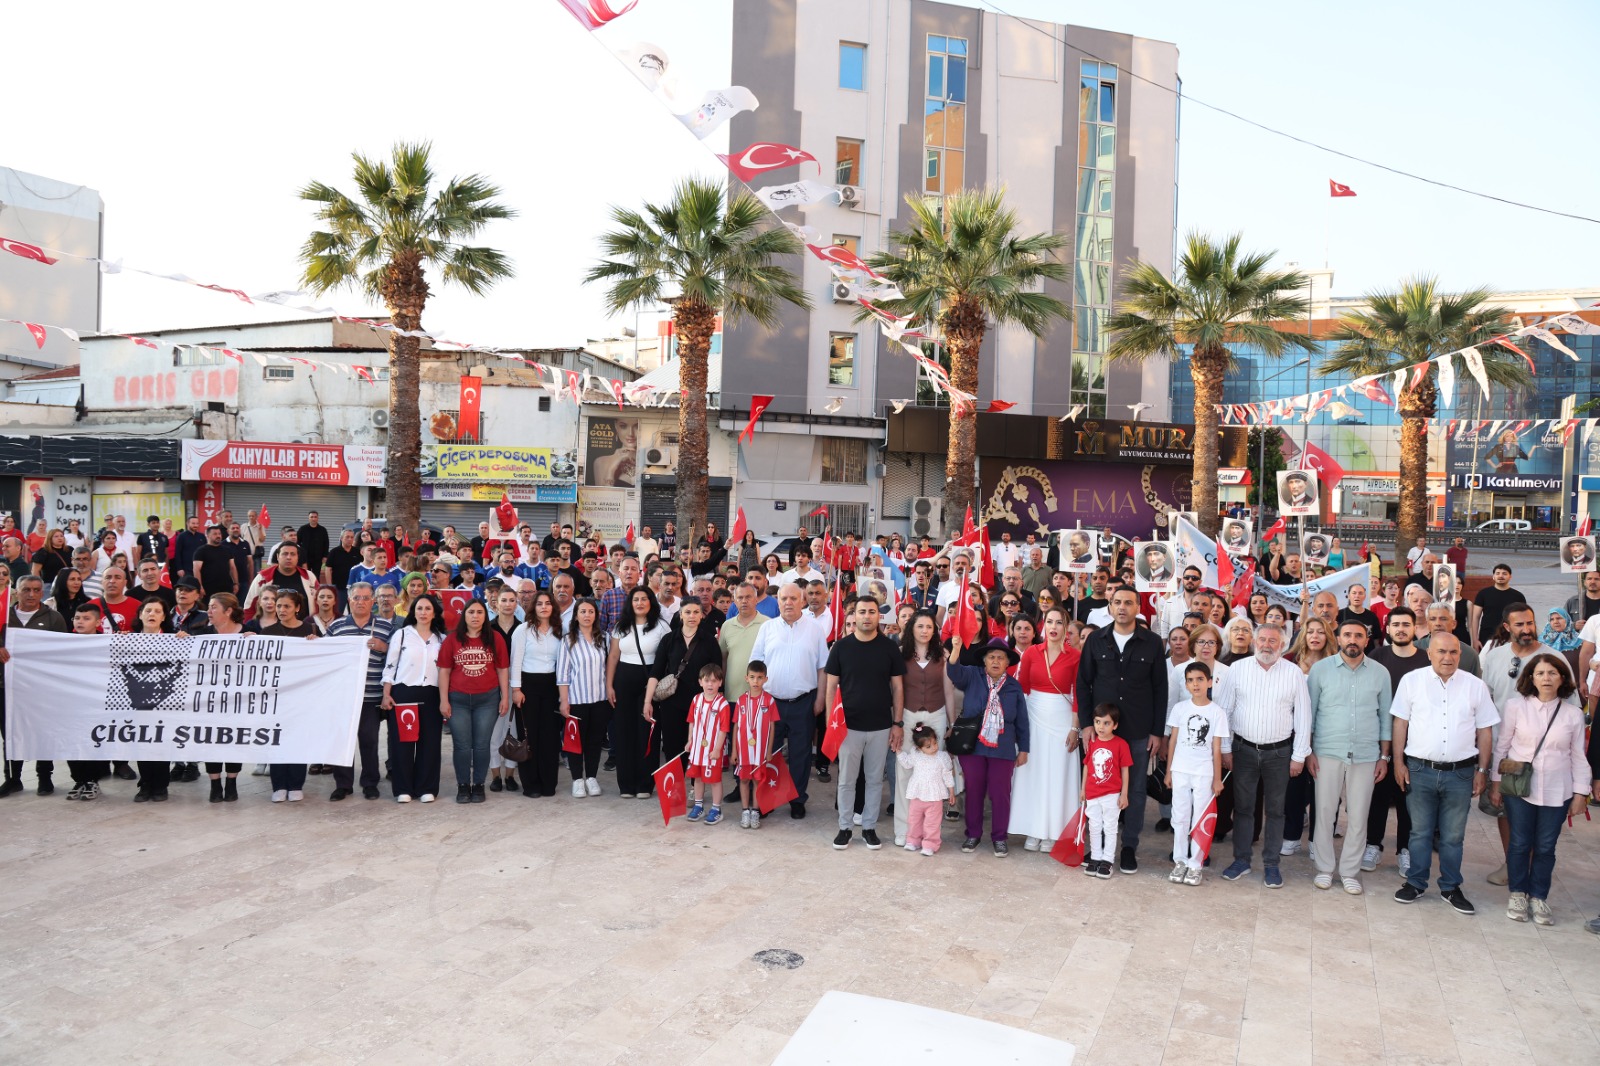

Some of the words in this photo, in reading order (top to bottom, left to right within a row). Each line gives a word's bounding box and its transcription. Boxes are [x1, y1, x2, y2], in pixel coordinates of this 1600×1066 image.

[590, 430, 615, 438] GOLD
[1118, 425, 1224, 450] MUR
[228, 447, 295, 467] KAHYALAR
[298, 450, 339, 469] PERDE
[440, 447, 477, 471] ÇİÇEK
[478, 449, 547, 470] DEPOSUNA
[1119, 450, 1163, 459] KUYUMCULUK
[243, 468, 267, 480] HAKAN
[271, 470, 299, 480] 0536
[301, 471, 315, 480] 511
[317, 472, 328, 480] 41
[330, 472, 341, 481] 01
[1367, 480, 1398, 489] AVRUPADE
[59, 484, 87, 496] Dink
[56, 498, 88, 515] Depo
[95, 495, 182, 518] KAHYALAR
[204, 482, 216, 528] KAHYA
[1072, 489, 1137, 515] EMA
[196, 660, 281, 689] DÜŞÜNCE
[192, 689, 278, 715] DERNEĞİ
[90, 719, 166, 748] ÇİĞLİ
[172, 723, 282, 749] ŞUBESİ
